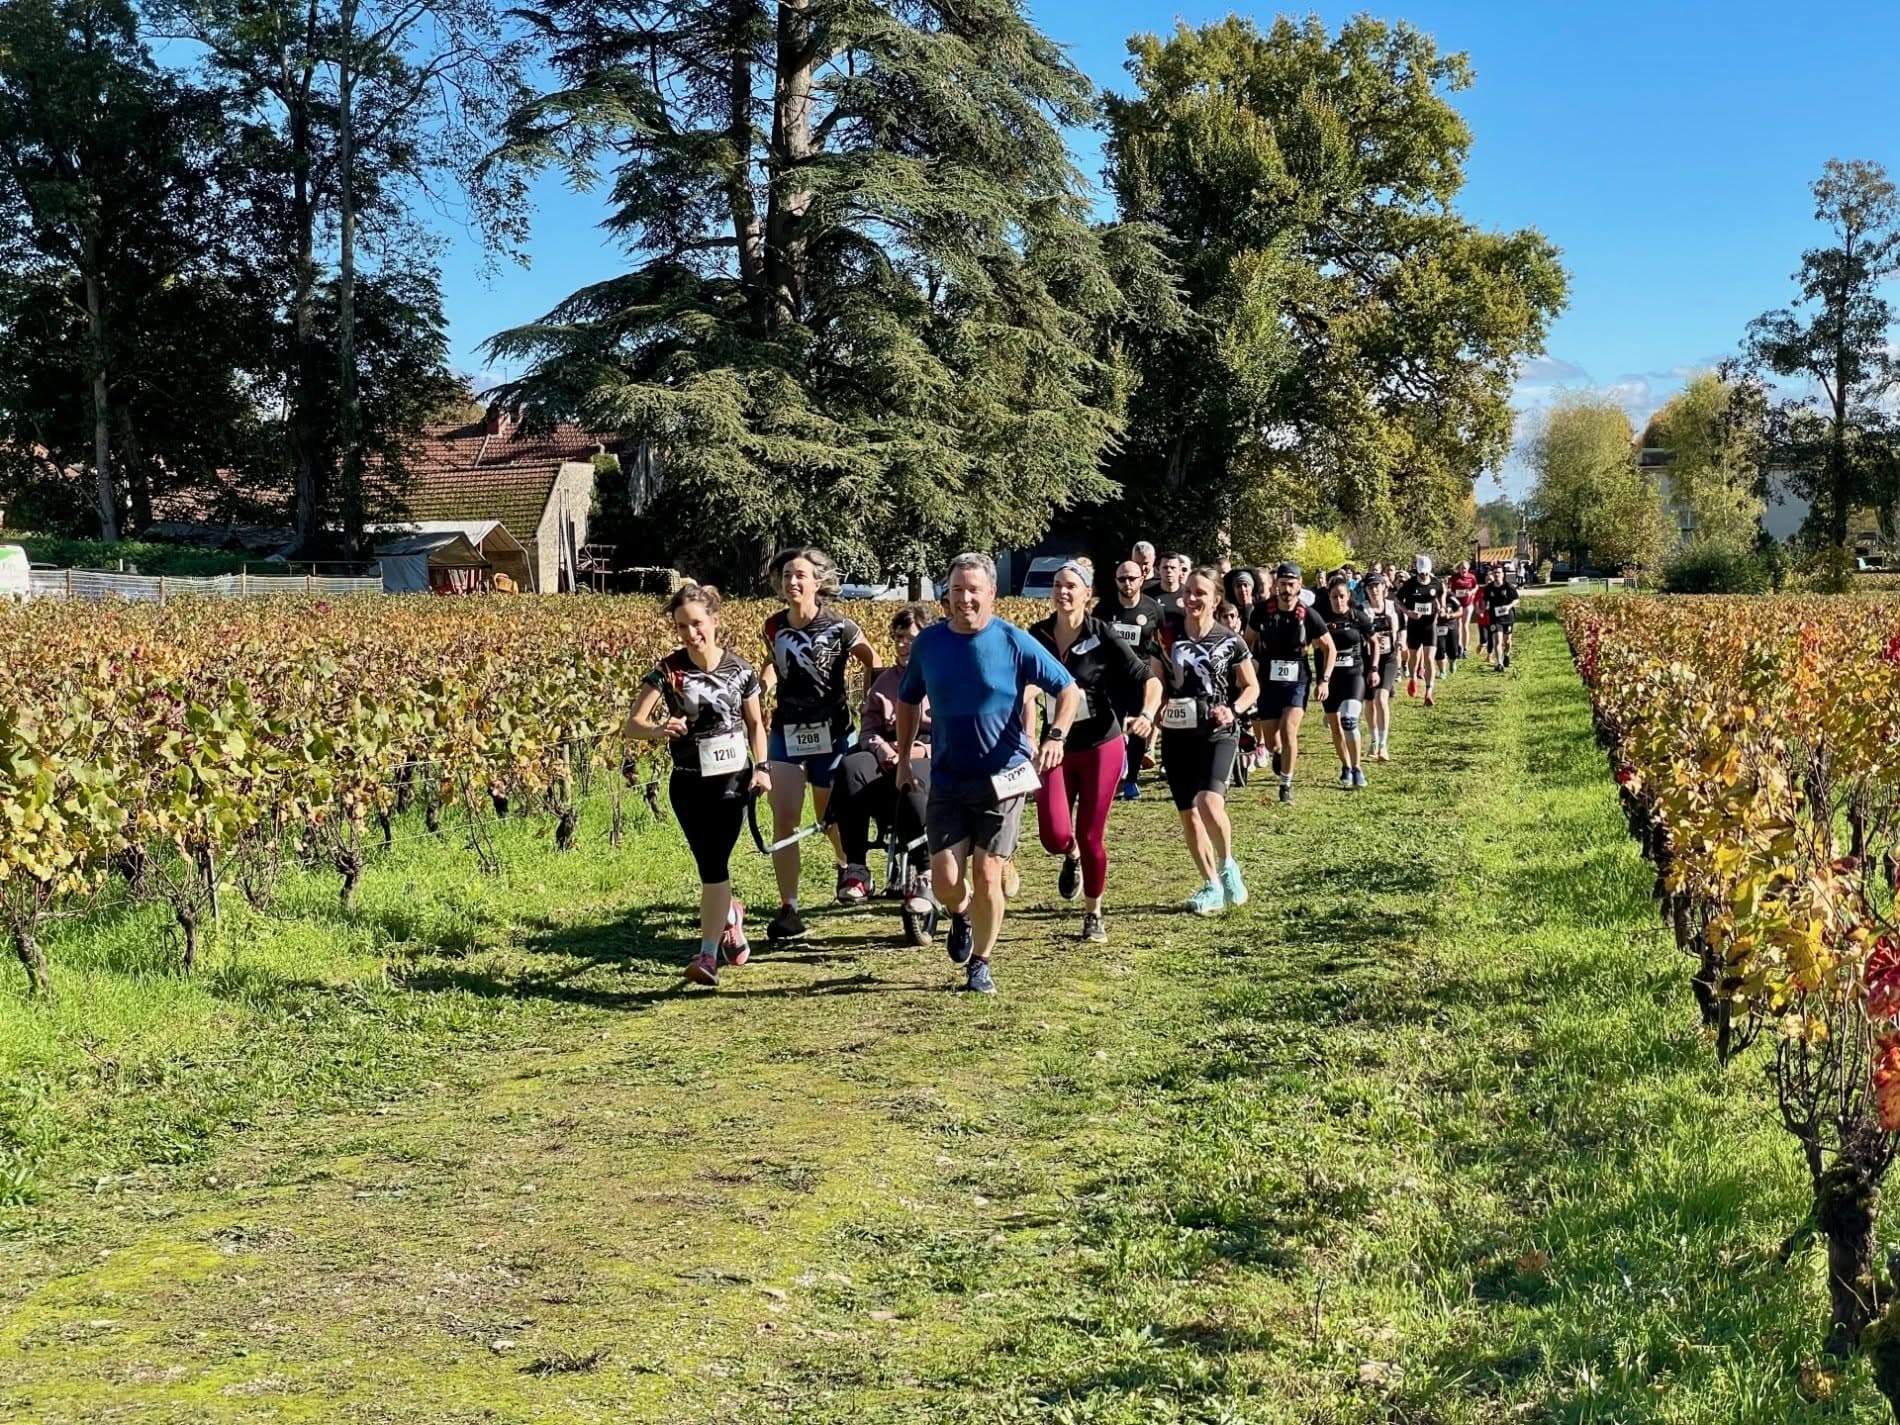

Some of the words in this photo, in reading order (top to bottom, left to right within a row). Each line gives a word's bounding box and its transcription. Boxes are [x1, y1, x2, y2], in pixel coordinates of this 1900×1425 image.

[1278, 667, 1288, 676] 20
[1167, 708, 1186, 719] 1205
[796, 732, 820, 745] 1208
[713, 747, 737, 762] 1210
